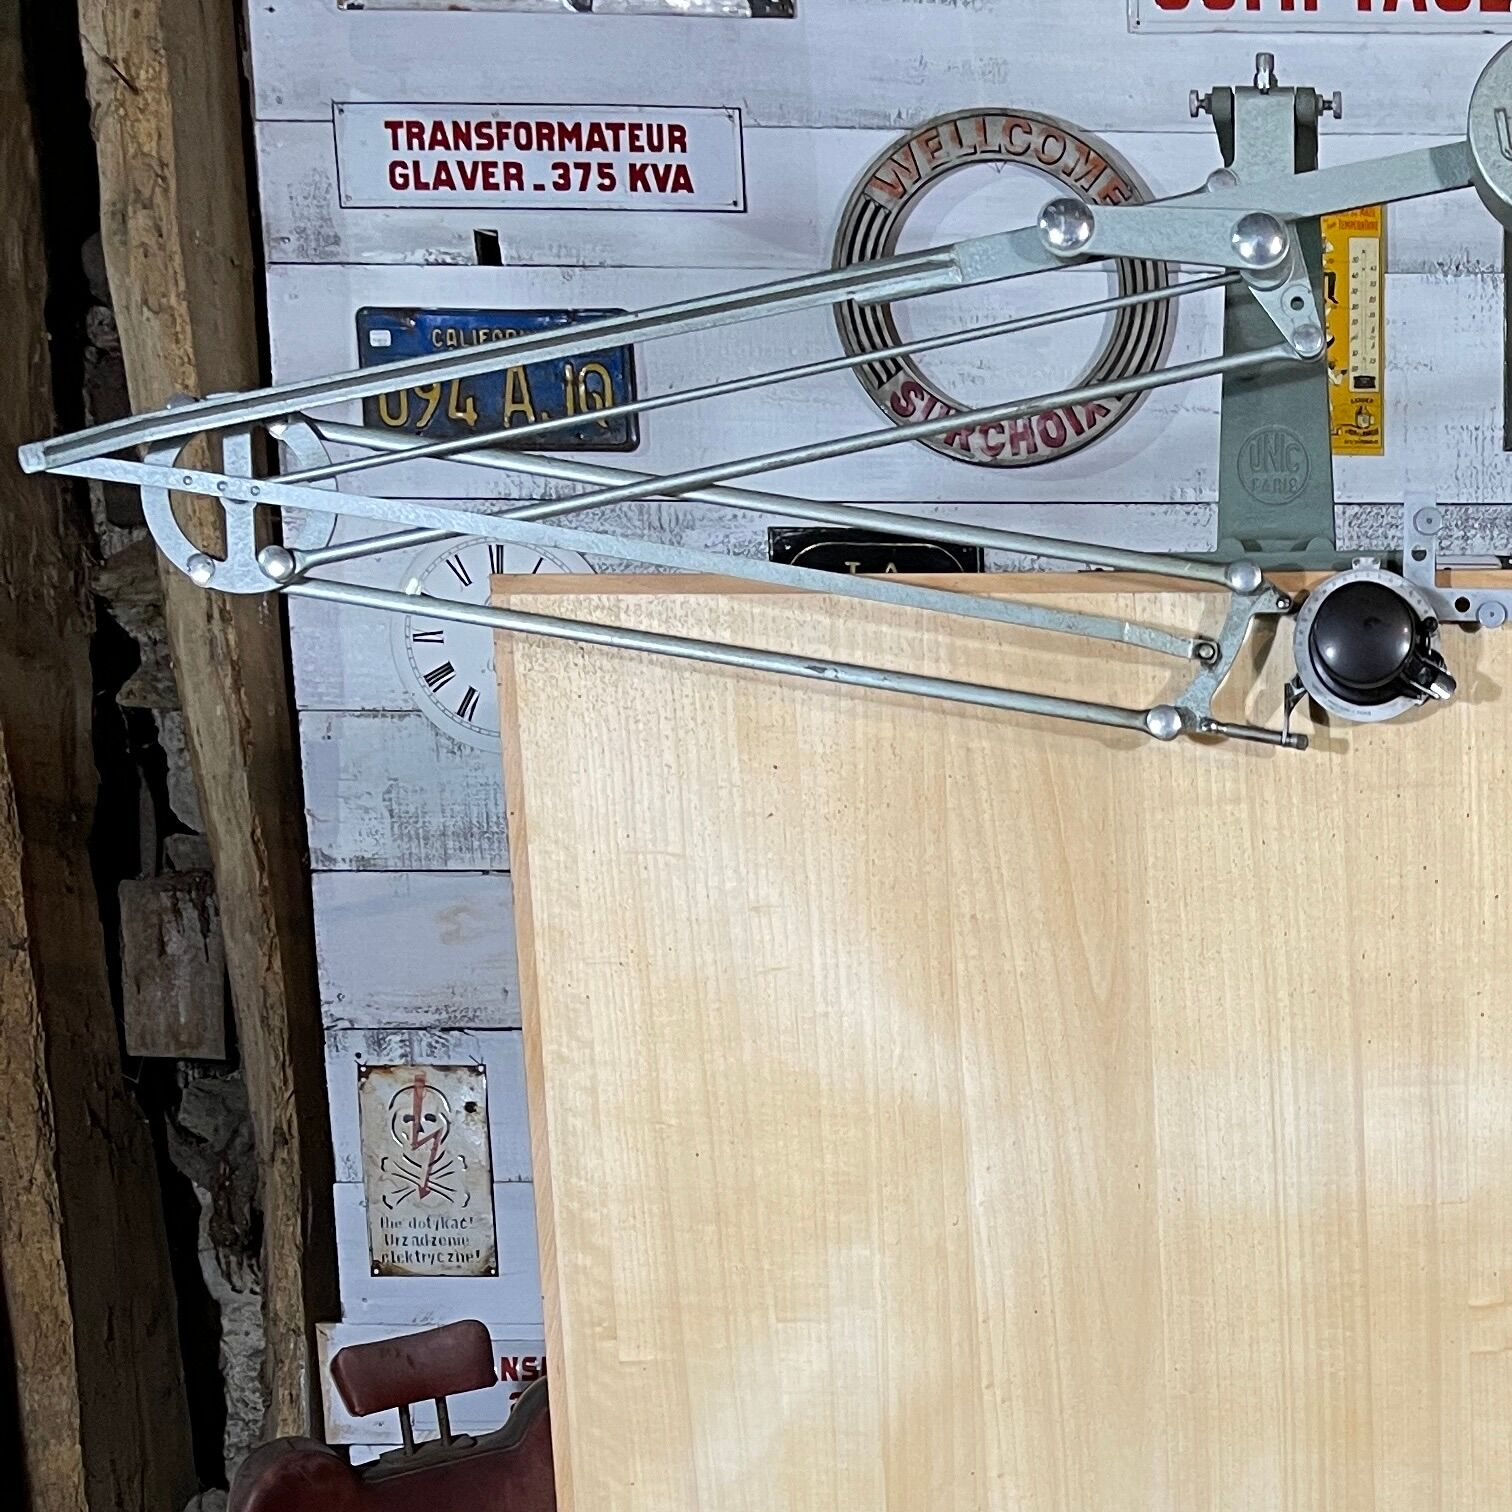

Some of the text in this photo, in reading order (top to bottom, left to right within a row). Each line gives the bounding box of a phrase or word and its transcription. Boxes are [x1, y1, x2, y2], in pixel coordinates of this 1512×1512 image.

[384, 120, 687, 153] TRANSFORMATEUR
[867, 116, 1133, 205] WELLCOME
[629, 163, 695, 193] KVA
[432, 328, 530, 347] CALIFOR
[1249, 433, 1300, 473] UNIC
